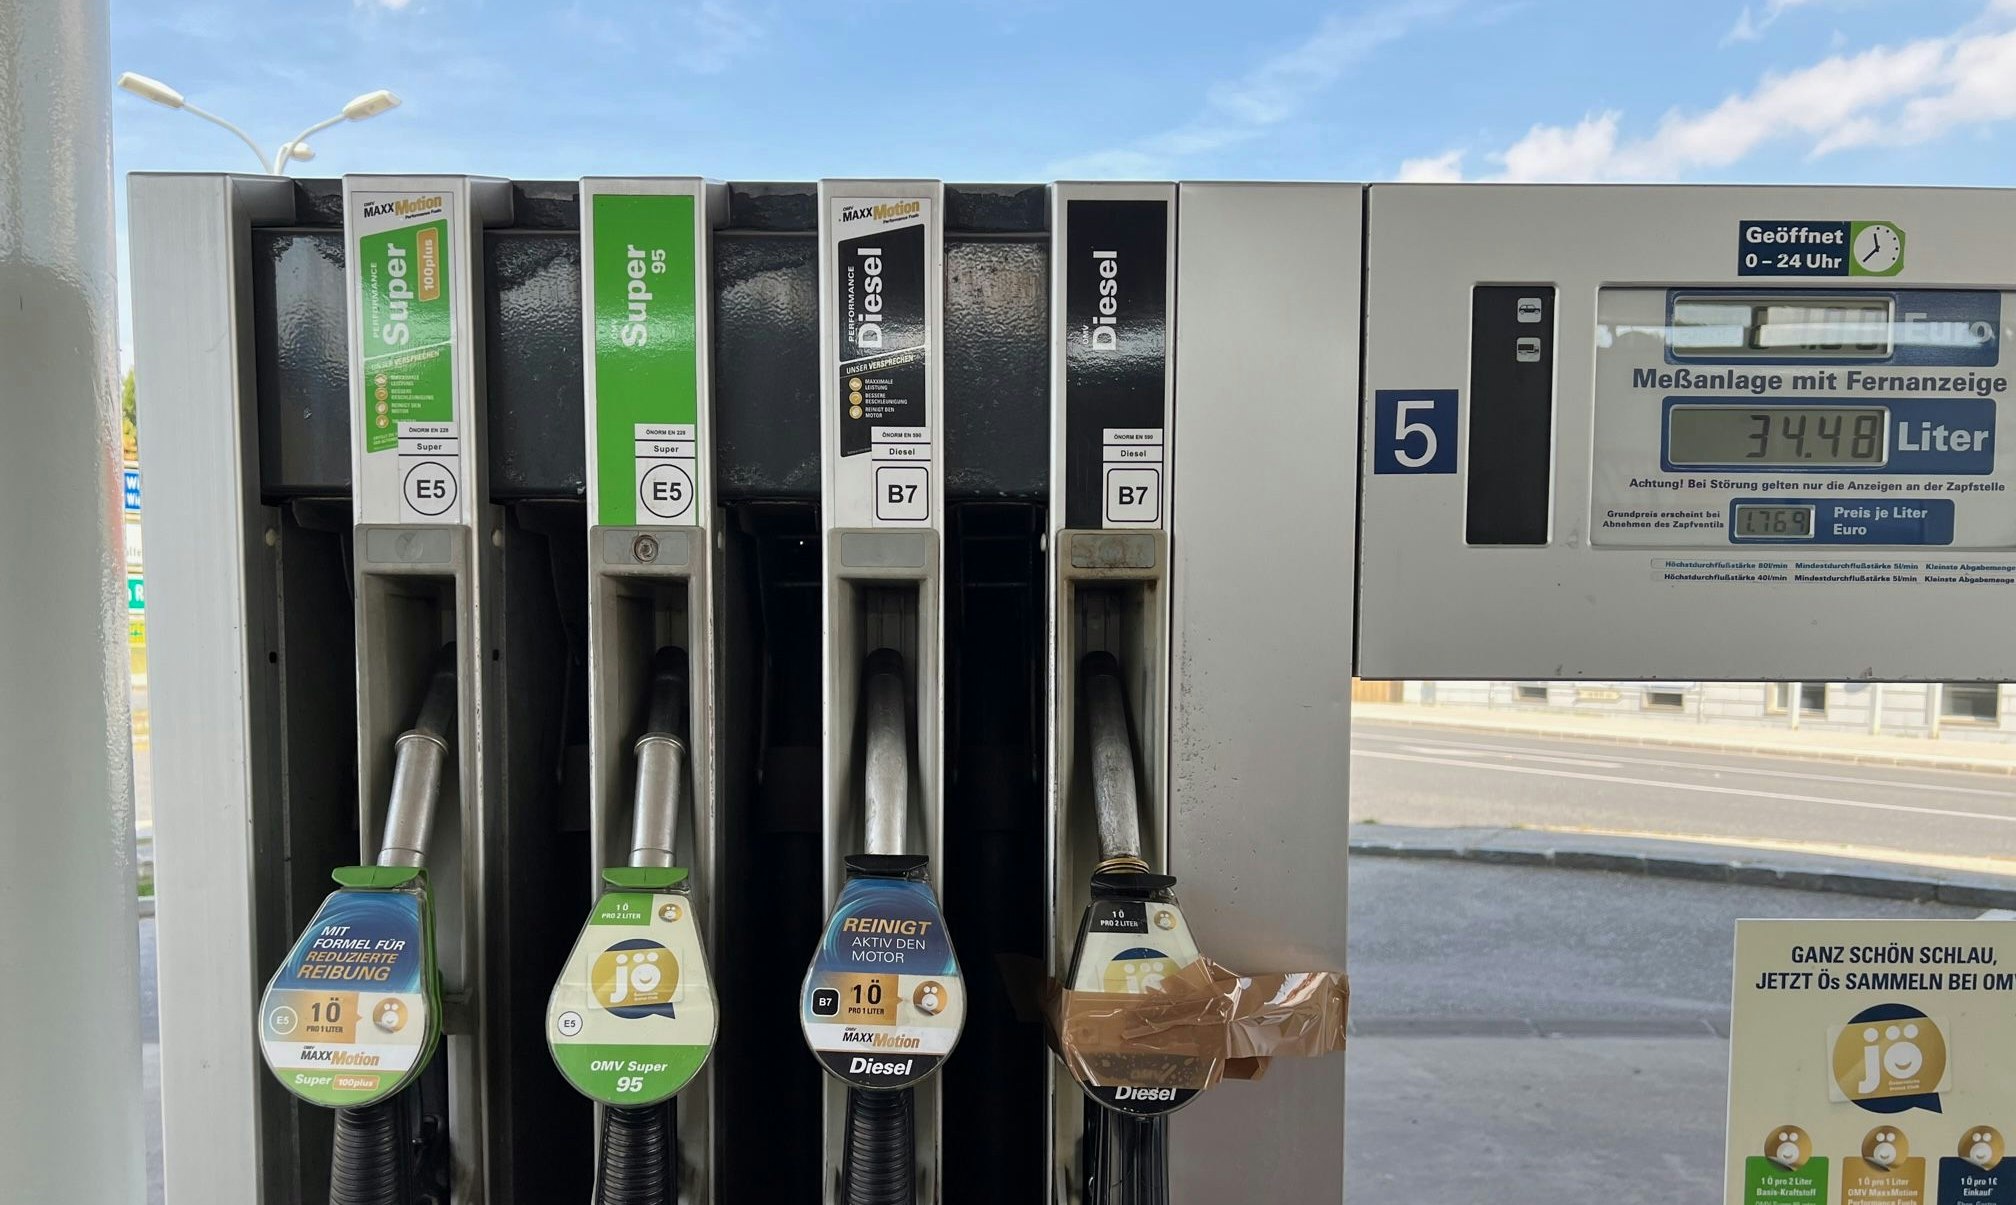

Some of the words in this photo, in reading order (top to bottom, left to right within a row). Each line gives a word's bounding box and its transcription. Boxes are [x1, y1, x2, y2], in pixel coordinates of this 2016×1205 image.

[1746, 226, 1844, 245] Geöffnet
[423, 239, 435, 291] 100plus
[651, 249, 666, 274] 95
[1745, 253, 1758, 268] 0
[1776, 253, 1802, 268] 24
[1806, 253, 1842, 269] Uhr
[370, 262, 380, 338] PERFORMANCE
[383, 243, 414, 346] Super
[620, 244, 653, 347] Super
[857, 248, 883, 348] Diesel
[1092, 250, 1118, 351] Diesel
[1081, 324, 1089, 345] OMV
[1904, 312, 1995, 344] Euro
[846, 363, 868, 374] UNSER
[1632, 368, 1784, 397] Meßanlage
[1792, 370, 1837, 391] mit
[1847, 371, 2008, 397] Fernanzeige
[1394, 400, 1438, 468] 5
[1746, 414, 1879, 459] 34.48
[1898, 421, 1990, 452] Liter
[416, 443, 443, 452] Super
[653, 445, 680, 454] Super
[889, 448, 916, 456] Diesel
[1120, 450, 1147, 458] Diesel
[416, 479, 447, 499] E5
[653, 481, 682, 501] E5
[888, 484, 918, 504] B7
[1629, 478, 1685, 492] Achtung!
[1687, 478, 1707, 491] Bei
[1710, 479, 1758, 493] Störung
[1762, 480, 1800, 492] gelten
[1803, 482, 1824, 491] nur
[1826, 480, 1845, 491] die
[1848, 481, 1903, 493] Anzeigen
[1906, 483, 1920, 491] an
[1923, 481, 1944, 491] der
[1946, 481, 2006, 494] Zapfstelle
[1119, 486, 1149, 506] B7
[1607, 510, 1659, 520] Grundpreis
[1660, 510, 1704, 519] erscheint
[1707, 510, 1721, 519] bei
[1745, 510, 1806, 533] 1.769
[1833, 506, 1872, 520] Preis
[1875, 506, 1890, 521] je
[1893, 507, 1929, 520] Liter
[1602, 519, 1651, 529] Abnehmen
[1654, 520, 1670, 529] des
[1672, 520, 1725, 530] Zapfventils
[1833, 523, 1868, 536] Euro
[1925, 563, 1959, 571] Kleinste
[1924, 575, 1957, 583] Kleinste
[1958, 576, 2015, 584] Abgabemenge
[1112, 910, 1117, 919] 1
[1118, 909, 1125, 919] Ö
[843, 917, 932, 936] REINIGT
[1100, 919, 1114, 927] PRO
[321, 926, 351, 937] MIT
[313, 938, 371, 951] FORMEL
[375, 938, 407, 951] FÜR
[851, 936, 893, 949] AKTIV
[896, 938, 926, 950] DEN
[305, 951, 399, 964] REDUZIERTE
[851, 950, 905, 964] MOTOR
[1791, 946, 1845, 964] GANZ
[1849, 943, 1915, 964] SCHÖN
[1919, 947, 1998, 966] SCHLAU,
[296, 965, 391, 982] REIBUNG
[610, 952, 661, 1004] jö
[1755, 972, 1813, 990] JETZT
[1817, 969, 1841, 990] Ös
[1845, 973, 1943, 990] SAMMELN
[1948, 973, 1978, 991] BEI
[1983, 973, 2016, 991] OM
[853, 984, 862, 1004] 1
[867, 979, 882, 1005] Ö
[819, 997, 833, 1006] B7
[311, 1002, 320, 1023] 1
[325, 997, 341, 1023] Ö
[867, 1007, 885, 1015] LITER
[276, 1016, 290, 1025] E5
[563, 1019, 576, 1028] E5
[306, 1025, 320, 1033] PRO
[325, 1026, 344, 1034] LITER
[842, 1031, 921, 1049] MAXXMotion
[849, 1057, 913, 1076] Diesel
[1858, 1024, 1923, 1094] jö
[590, 1061, 625, 1072] OMV
[627, 1061, 668, 1074] Super
[295, 1074, 332, 1085] Super
[338, 1078, 374, 1088] 100plus
[616, 1076, 643, 1093] 95
[1115, 1085, 1176, 1101] Diesel
[1767, 1175, 1773, 1185] Ö
[1774, 1179, 1788, 1187] pro
[1864, 1176, 1870, 1186] Ö
[1871, 1179, 1885, 1187] pro
[1891, 1178, 1909, 1186] Liter
[1966, 1175, 1973, 1185] Ö
[1973, 1179, 1987, 1187] pro
[1756, 1188, 1817, 1196] Basis-Kraftstoff
[1868, 1189, 1918, 1197] MaxxMotion
